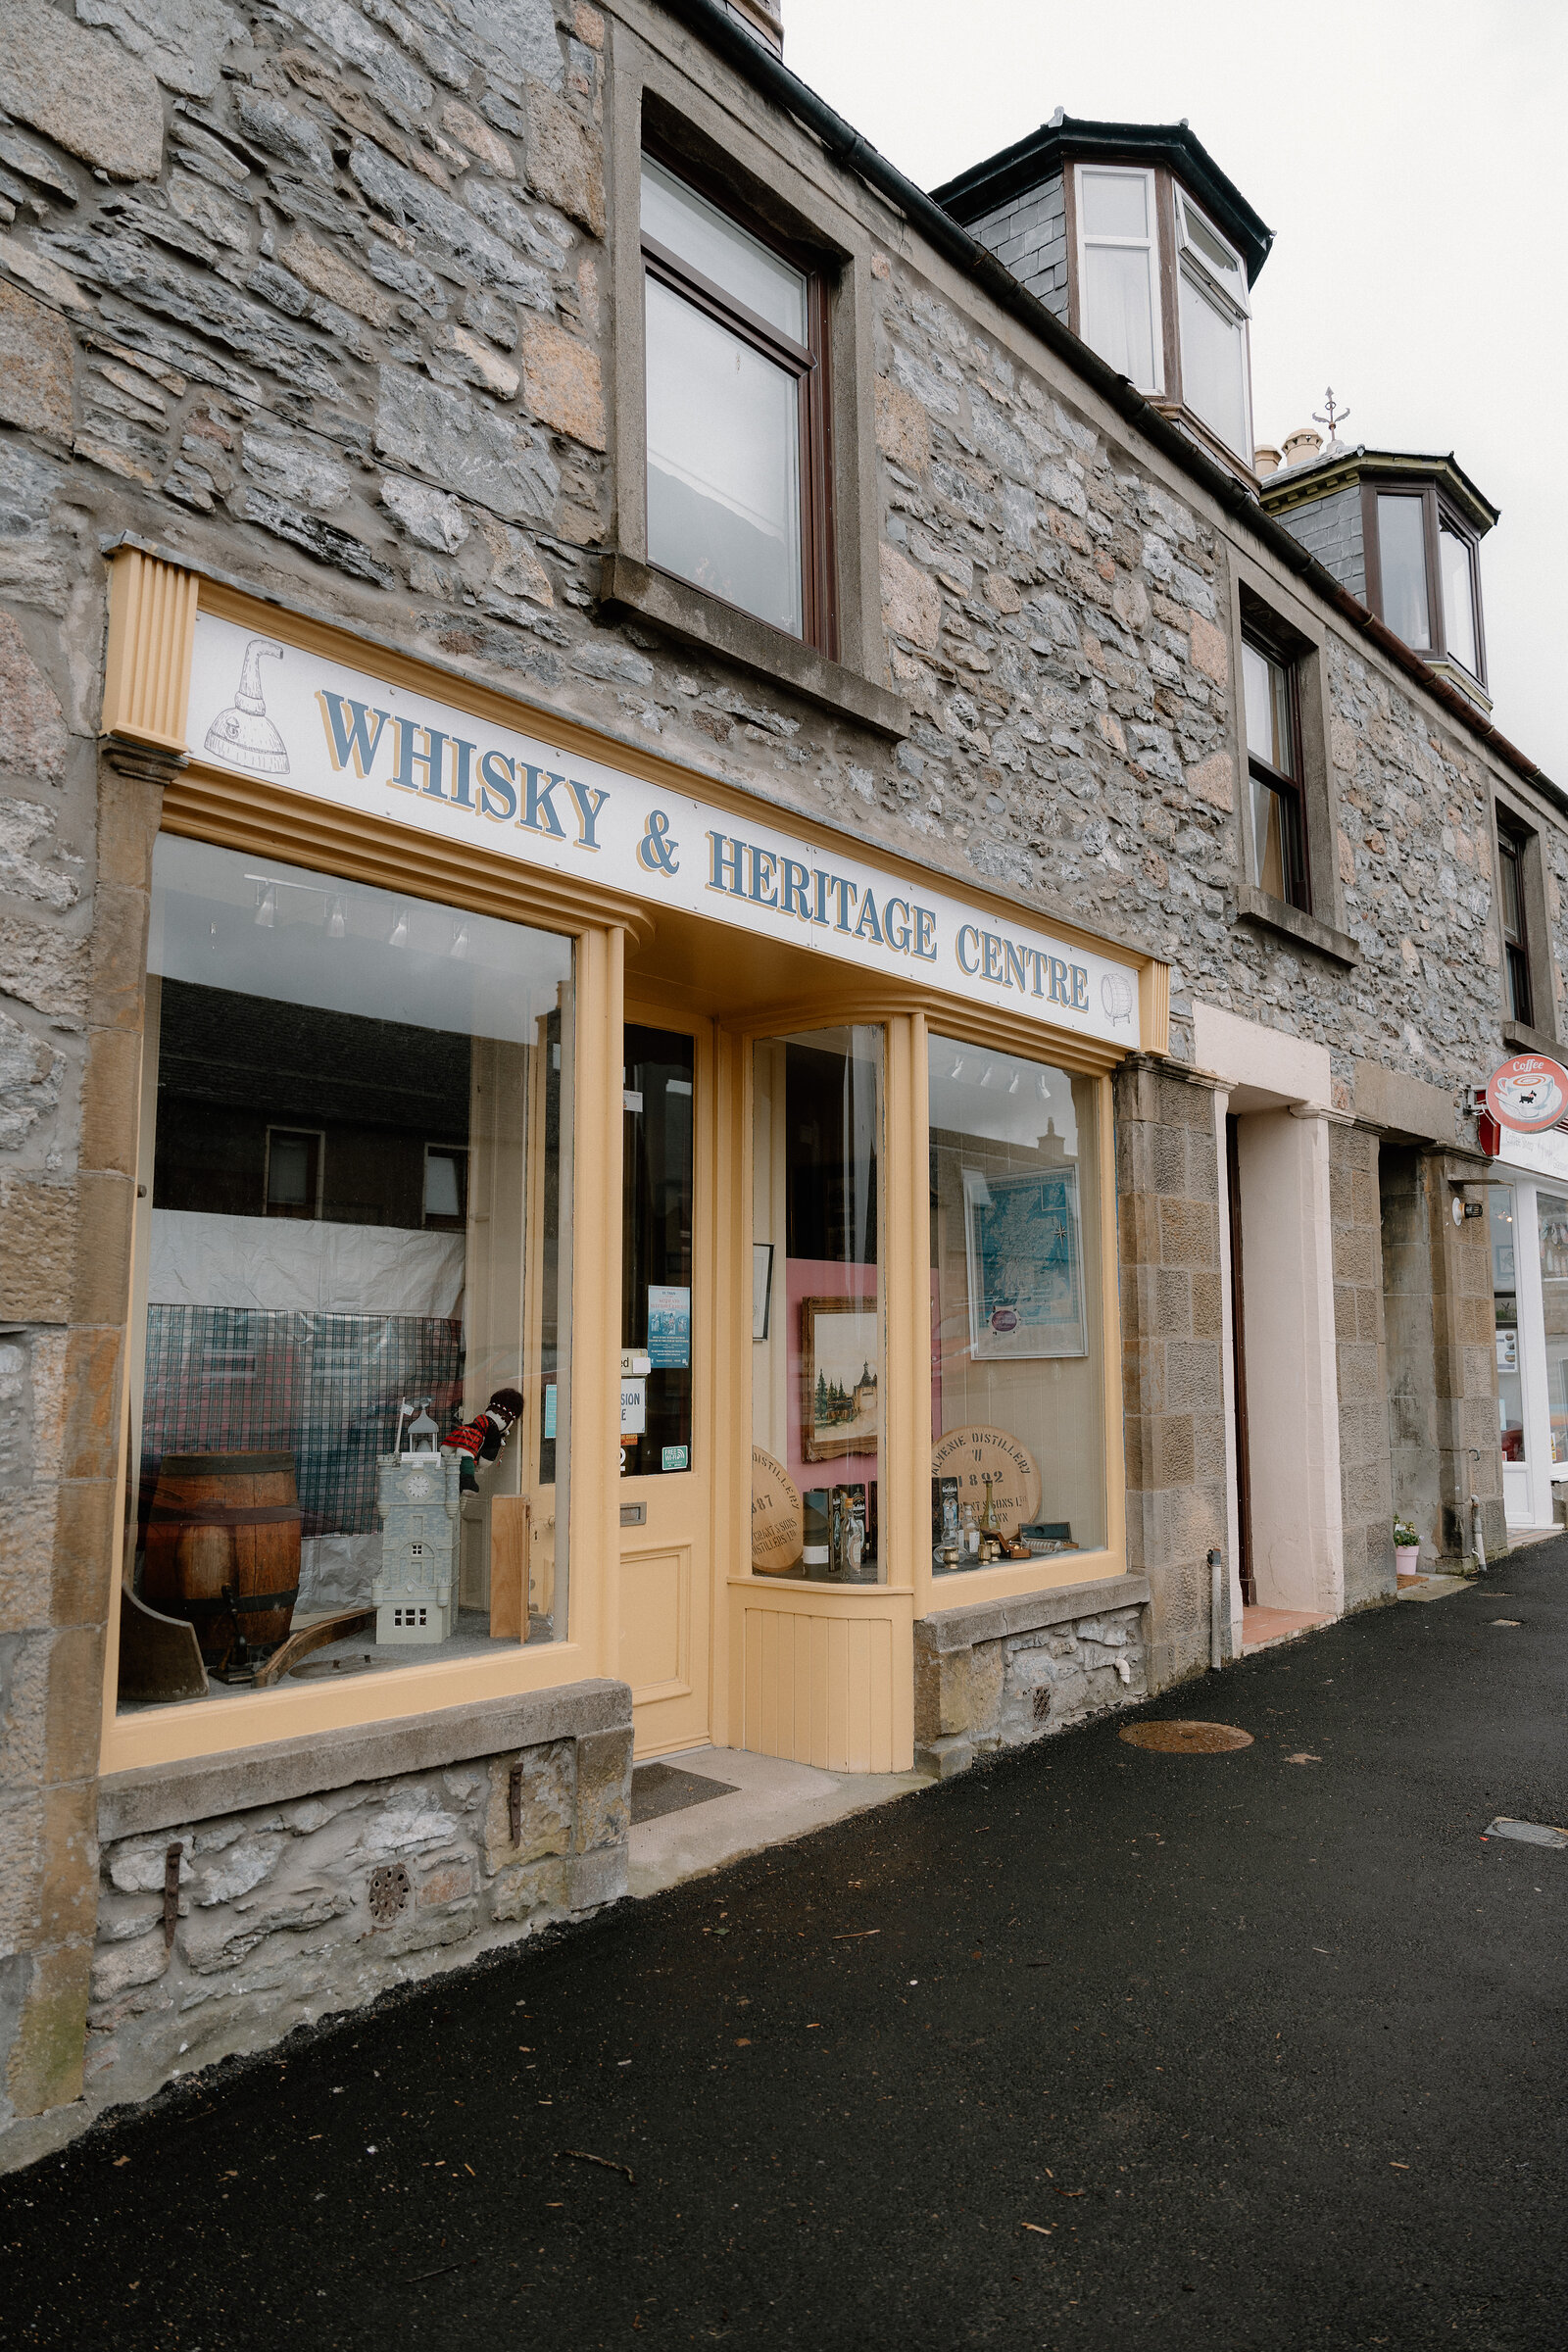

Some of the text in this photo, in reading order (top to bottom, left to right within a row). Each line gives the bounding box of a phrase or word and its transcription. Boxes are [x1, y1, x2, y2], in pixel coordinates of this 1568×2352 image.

[315, 689, 1090, 1014] WHISKY & HERITAGE CENTRE
[1512, 1058, 1544, 1073] Coffee
[971, 1433, 1031, 1474] DISTILLERY
[752, 1452, 800, 1510] DISTILLERY
[957, 1470, 1004, 1488] 1892
[991, 1497, 1013, 1509] SONS
[753, 1525, 775, 1542] GRANT
[779, 1517, 798, 1532] SONS
